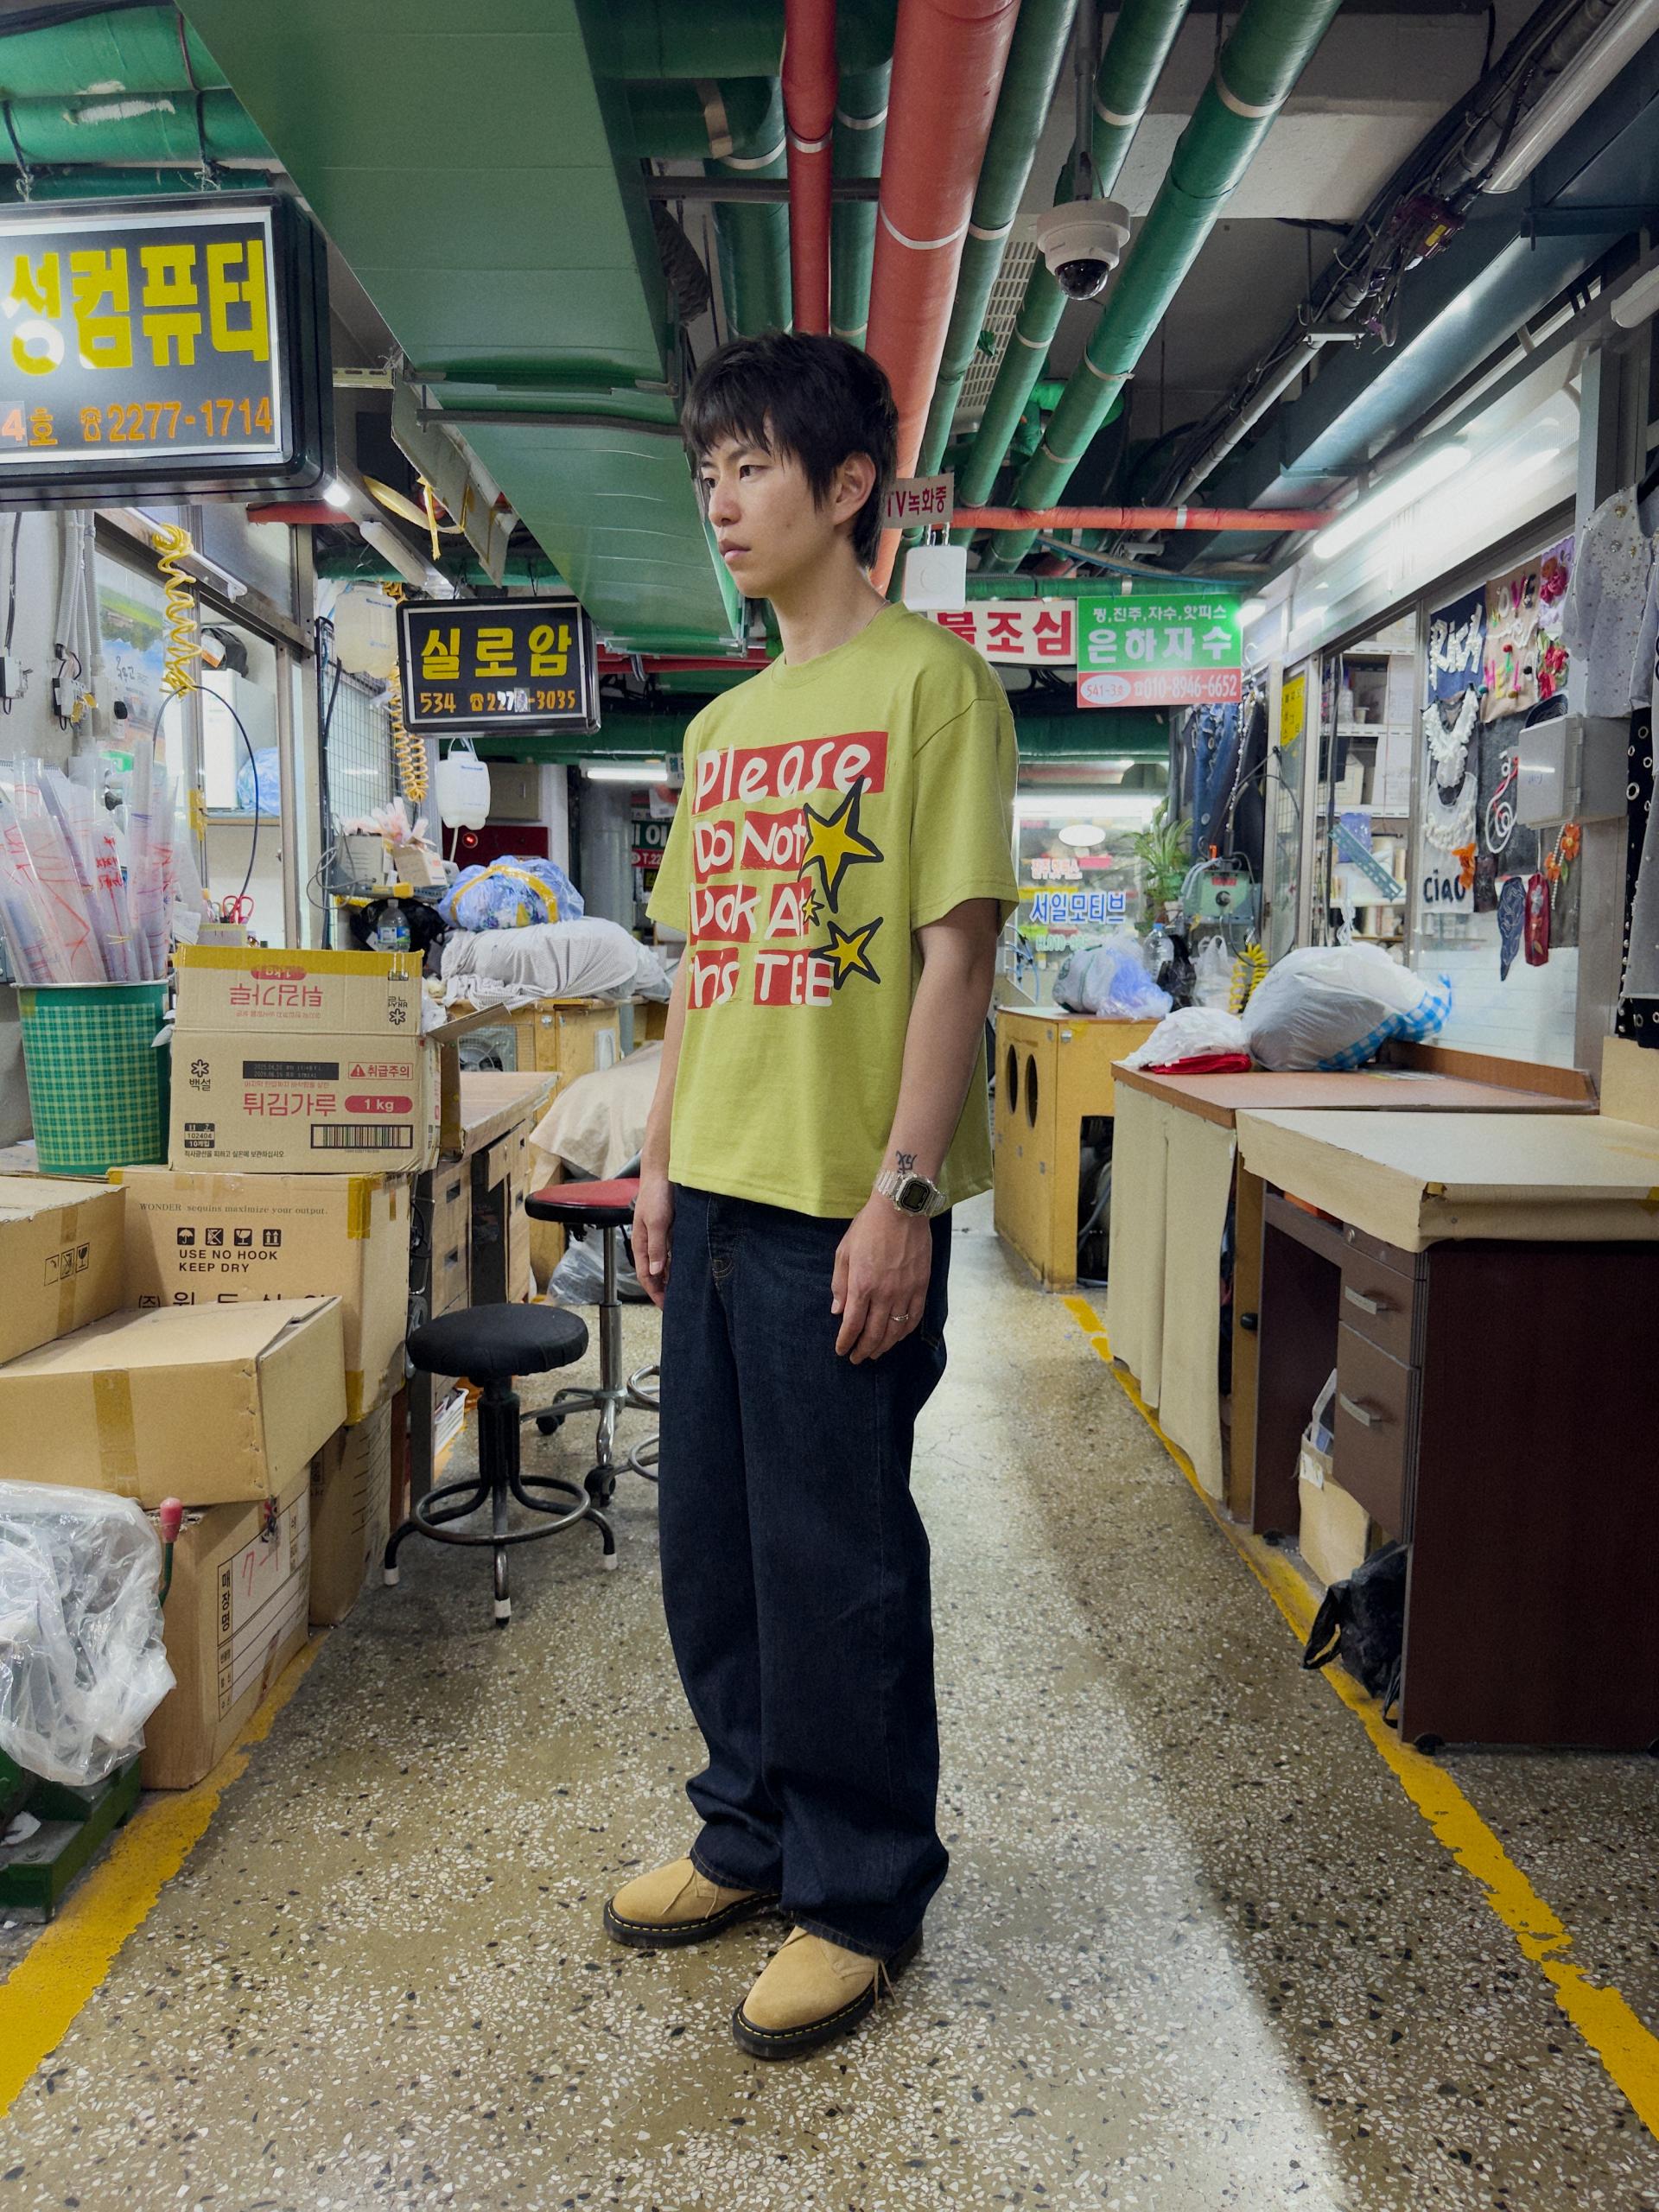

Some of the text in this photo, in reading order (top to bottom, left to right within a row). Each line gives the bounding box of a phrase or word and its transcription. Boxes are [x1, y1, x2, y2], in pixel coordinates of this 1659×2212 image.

[3, 239, 270, 375] 성컴퓨터
[421, 625, 572, 680] 실로암
[1087, 626, 1233, 664] 은하자수
[420, 692, 457, 714] 534
[753, 953, 836, 1007] TEE
[229, 982, 324, 1007] 튀김가루
[367, 1064, 410, 1078] 취급주의
[189, 1077, 212, 1092] 백설
[243, 1092, 337, 1117] 튀김가루
[376, 1097, 395, 1112] kg
[139, 1203, 182, 1212] WONDER
[225, 1205, 269, 1214] maximize
[271, 1207, 293, 1216] your
[179, 1249, 278, 1261] USE NO HOOK
[179, 1262, 250, 1273] KEEP DRY
